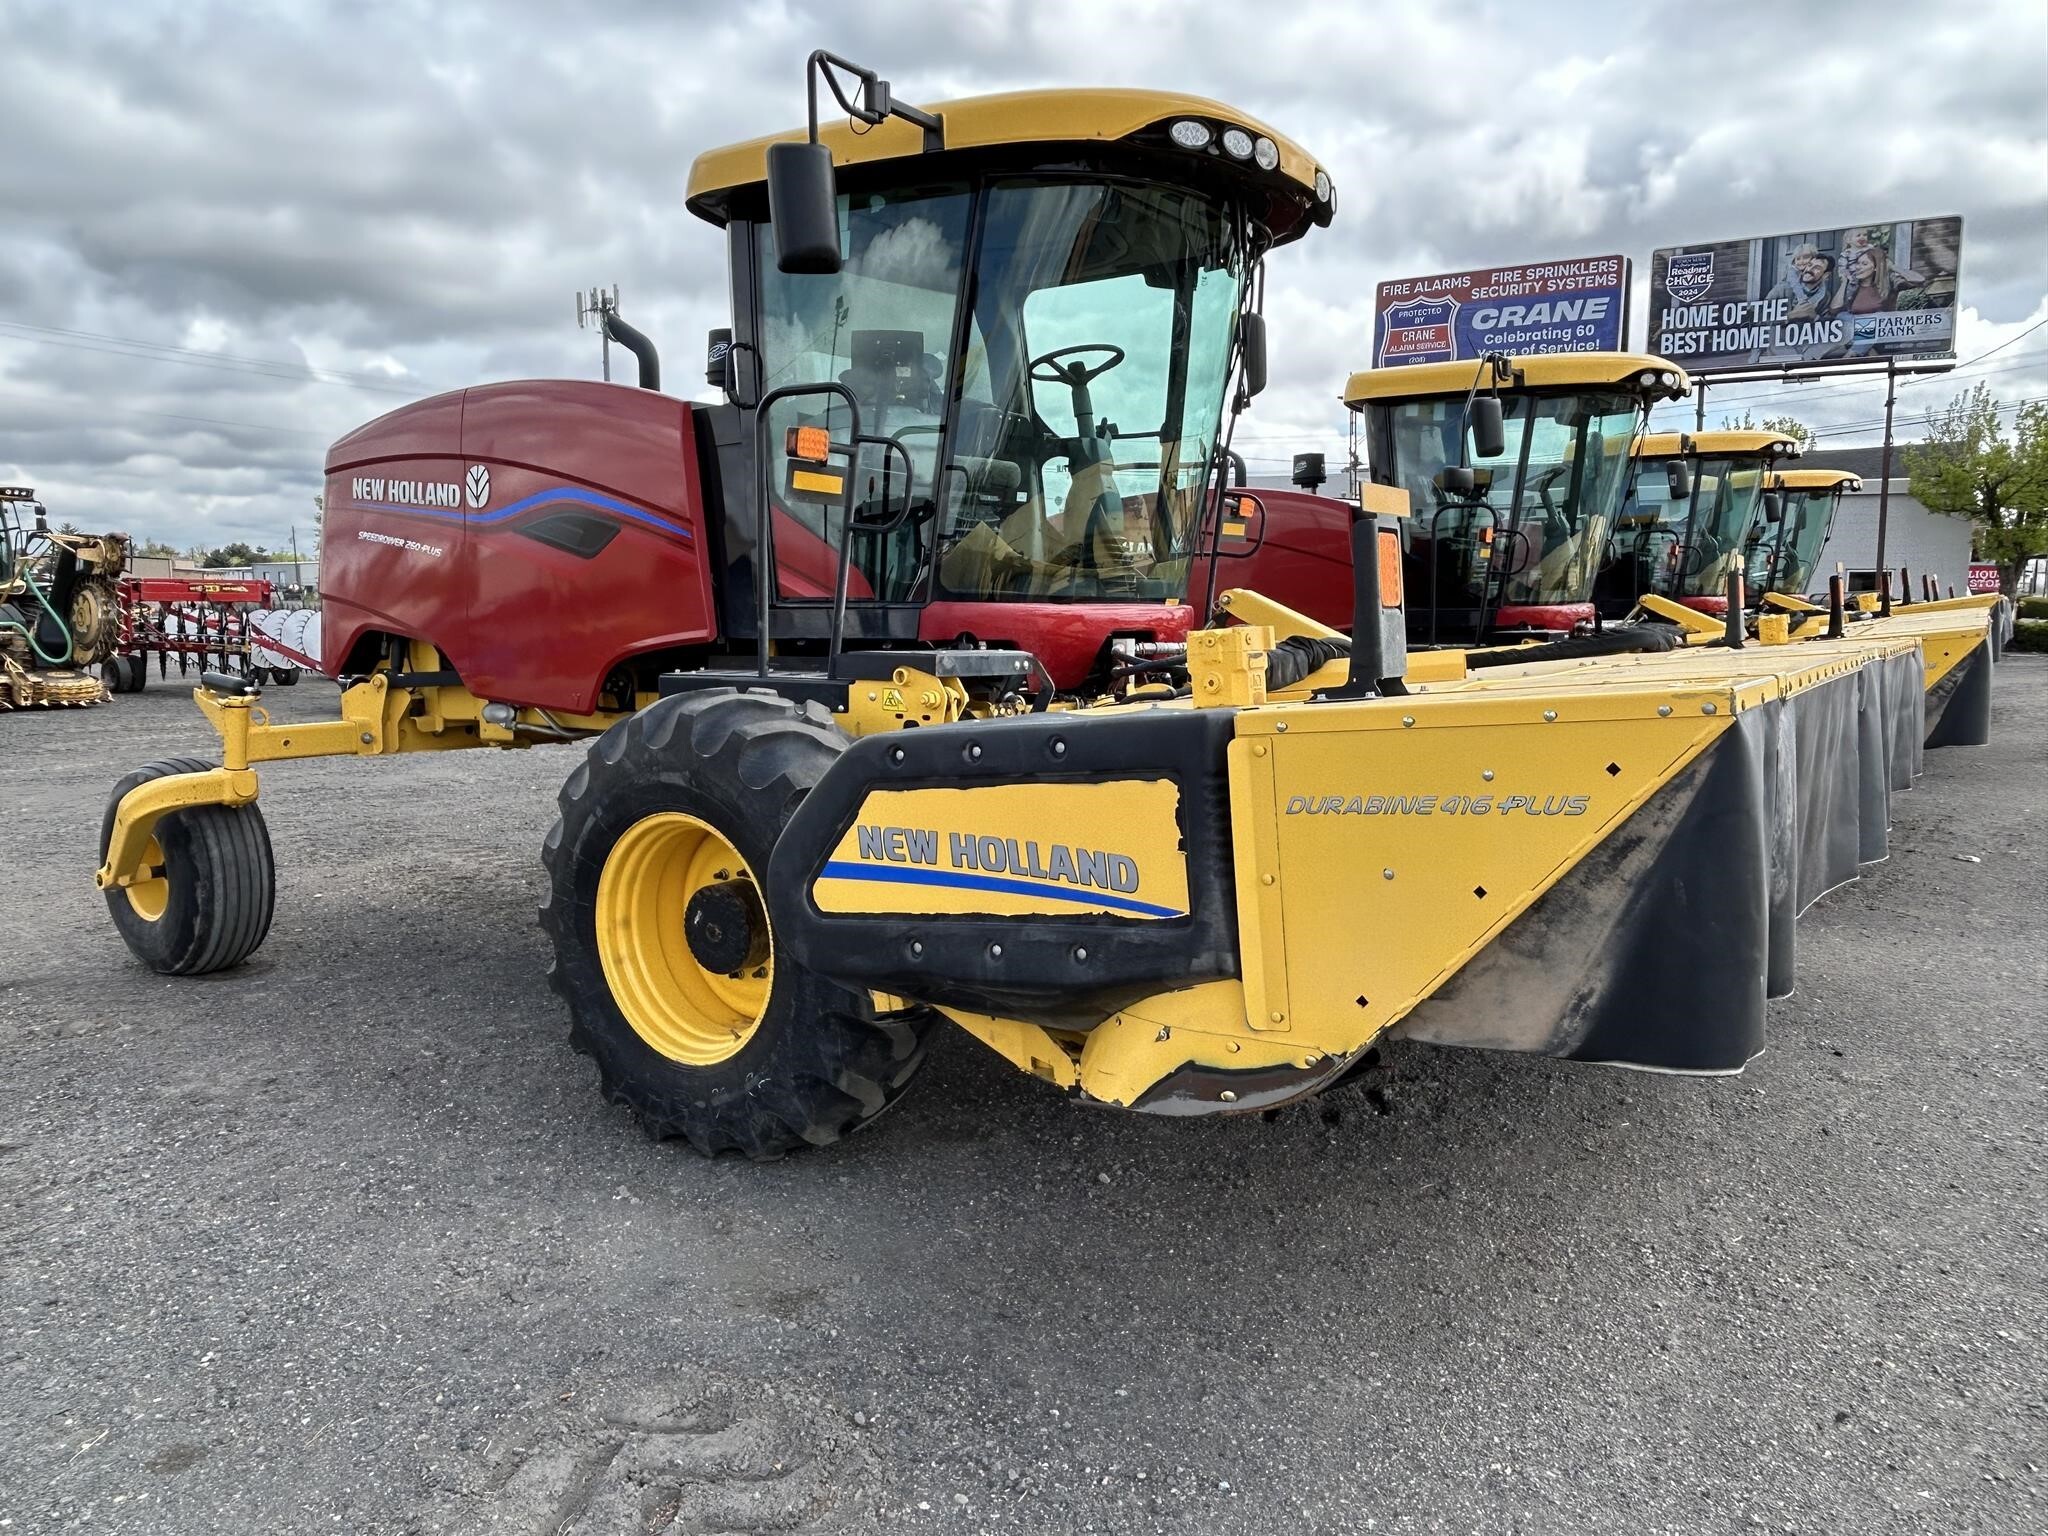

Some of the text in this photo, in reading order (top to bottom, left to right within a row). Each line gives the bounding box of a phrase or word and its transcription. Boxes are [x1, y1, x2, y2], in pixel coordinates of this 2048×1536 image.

[1491, 259, 1618, 284] FIRE SPRINKLERS
[1382, 275, 1471, 297] FIRE ALARMS
[1471, 273, 1617, 299] SECURITY SYSTEMS
[1398, 307, 1442, 318] PROTECTED
[1472, 296, 1610, 330] CRANE
[1662, 299, 1789, 330] HOME OF THE
[1878, 313, 1943, 328] FARMERS
[1402, 329, 1436, 342] CRANE
[1484, 324, 1595, 344] Celebrating 60
[1660, 320, 1844, 355] BEST HOME LOANS
[1878, 326, 1916, 337] BANK
[1389, 344, 1415, 353] ALARM
[1521, 343, 1536, 355] of
[1539, 339, 1600, 354] Service!
[352, 478, 462, 508] NEW HOLLAND
[358, 531, 405, 547] SPEEDROWER
[1968, 570, 2000, 580] LIQU
[1286, 795, 1439, 816] DURABINE
[1440, 795, 1494, 816] 416
[857, 824, 1140, 894] NEW HOLLAND
